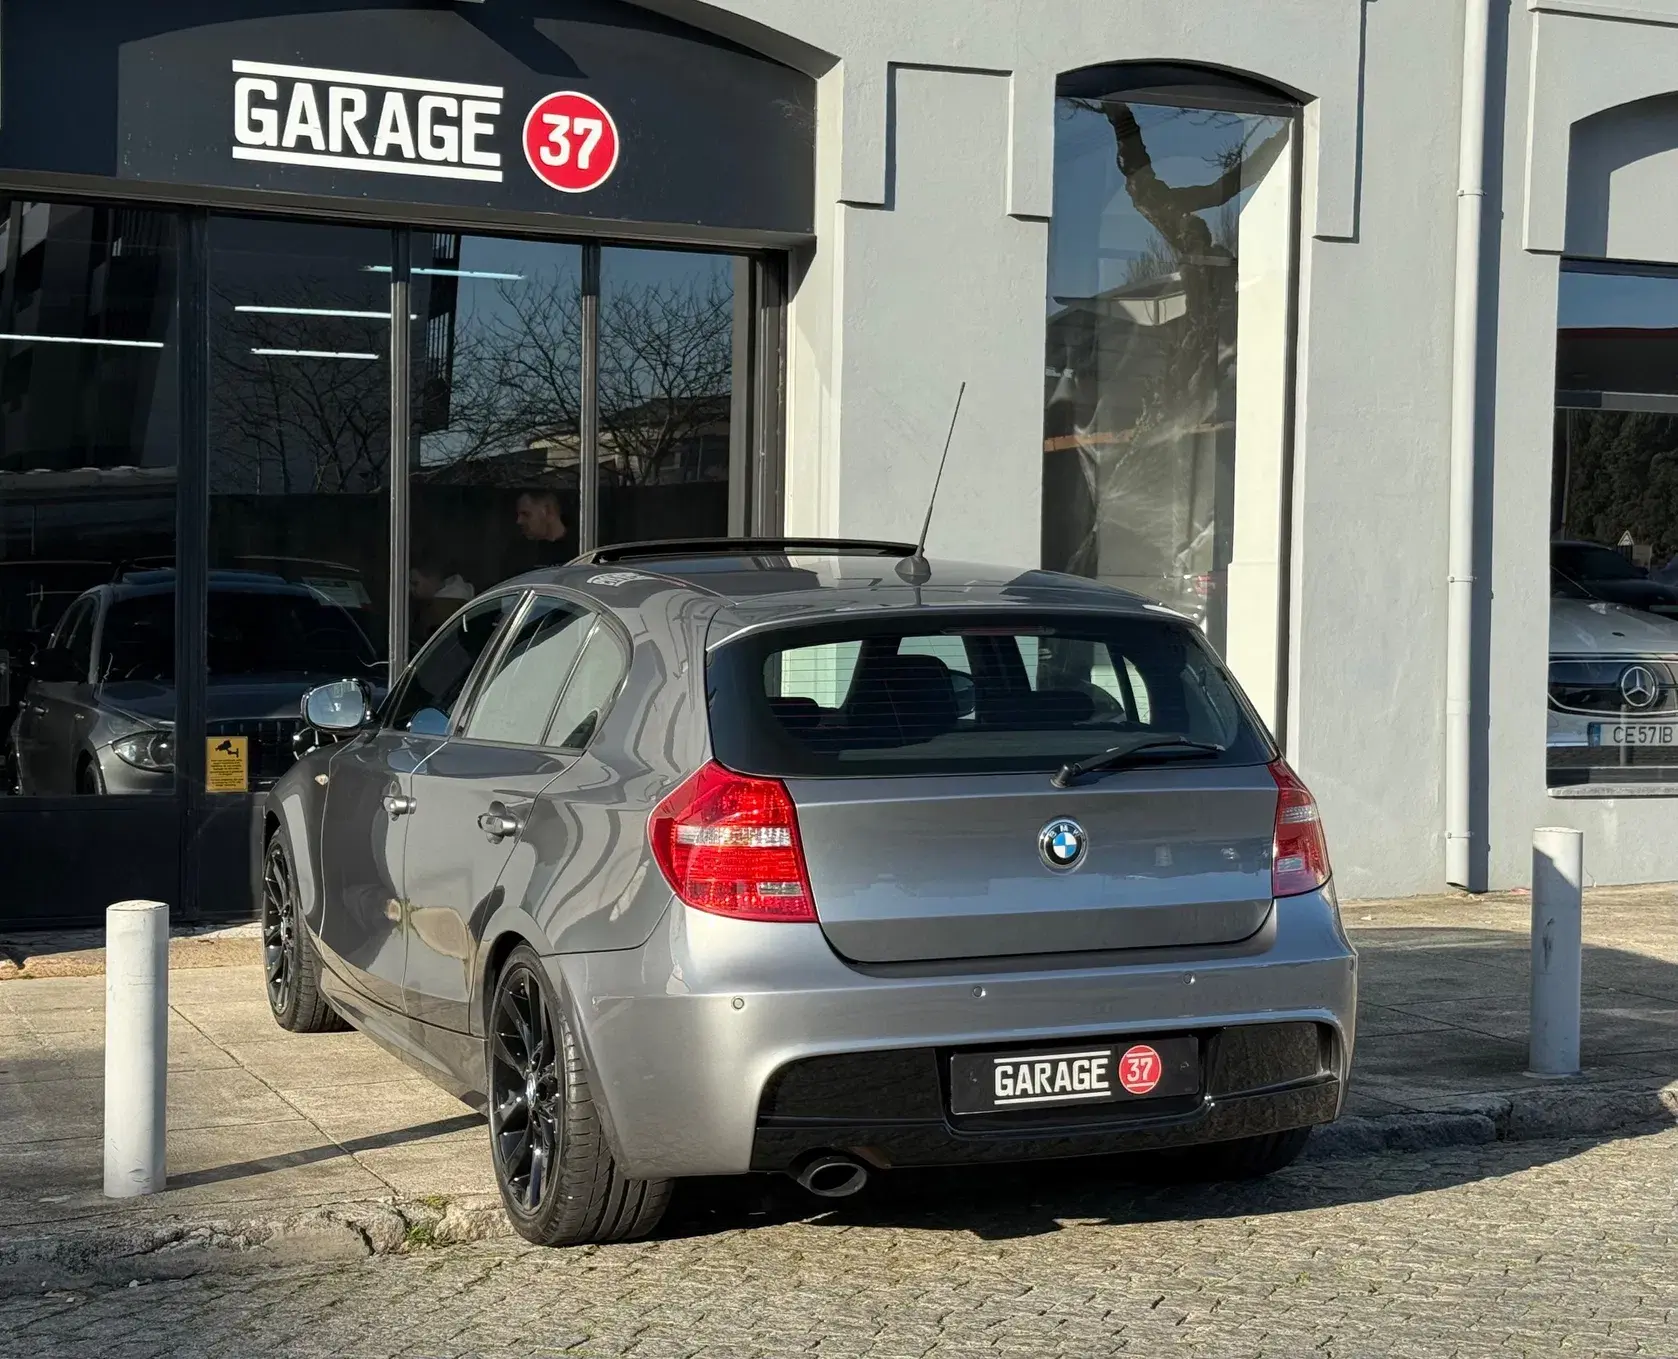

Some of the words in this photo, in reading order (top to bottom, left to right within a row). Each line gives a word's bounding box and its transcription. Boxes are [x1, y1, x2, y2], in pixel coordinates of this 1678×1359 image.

[234, 77, 501, 167] GARAGE
[539, 113, 603, 170] 37
[994, 1058, 1109, 1097] GARAGE
[1127, 1057, 1153, 1082] 37
